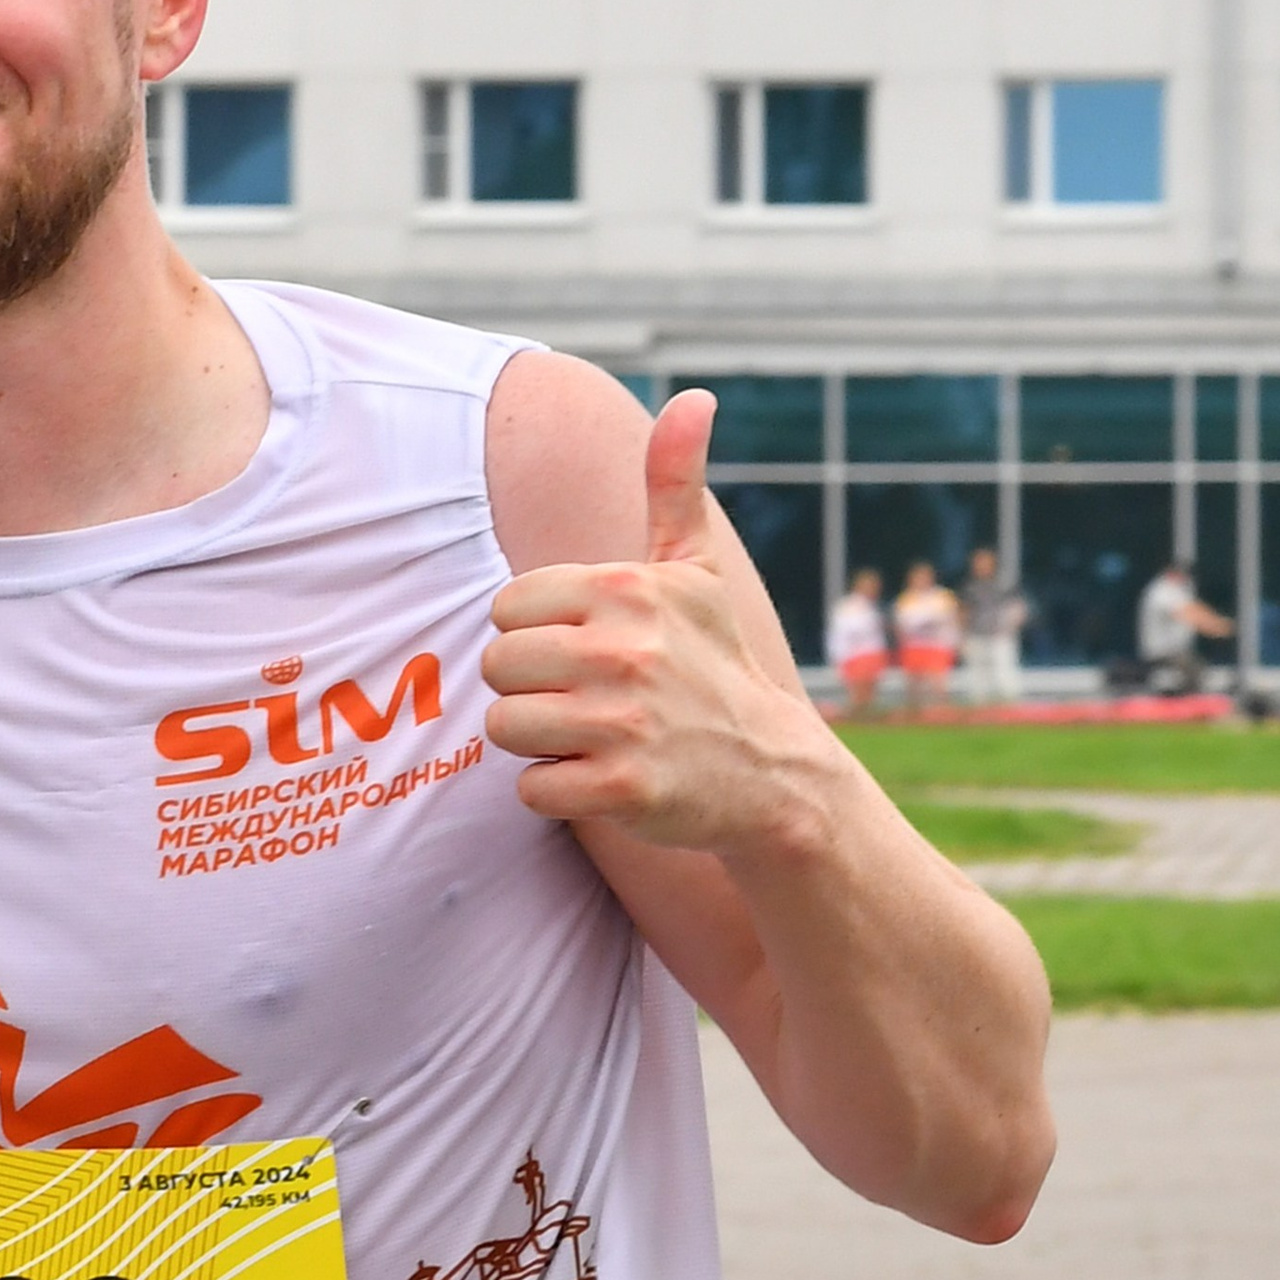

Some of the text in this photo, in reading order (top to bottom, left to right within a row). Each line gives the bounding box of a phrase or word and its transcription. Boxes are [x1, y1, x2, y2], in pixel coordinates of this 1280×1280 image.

[157, 755, 369, 823] СИБИРСКИЙ
[157, 735, 484, 850] МЕЖДУНАРОДНЫЙ
[157, 823, 340, 878] МАРАФОН
[120, 1164, 312, 1192] 3 АВГУСТА 2024
[220, 1193, 277, 1210] 42,195
